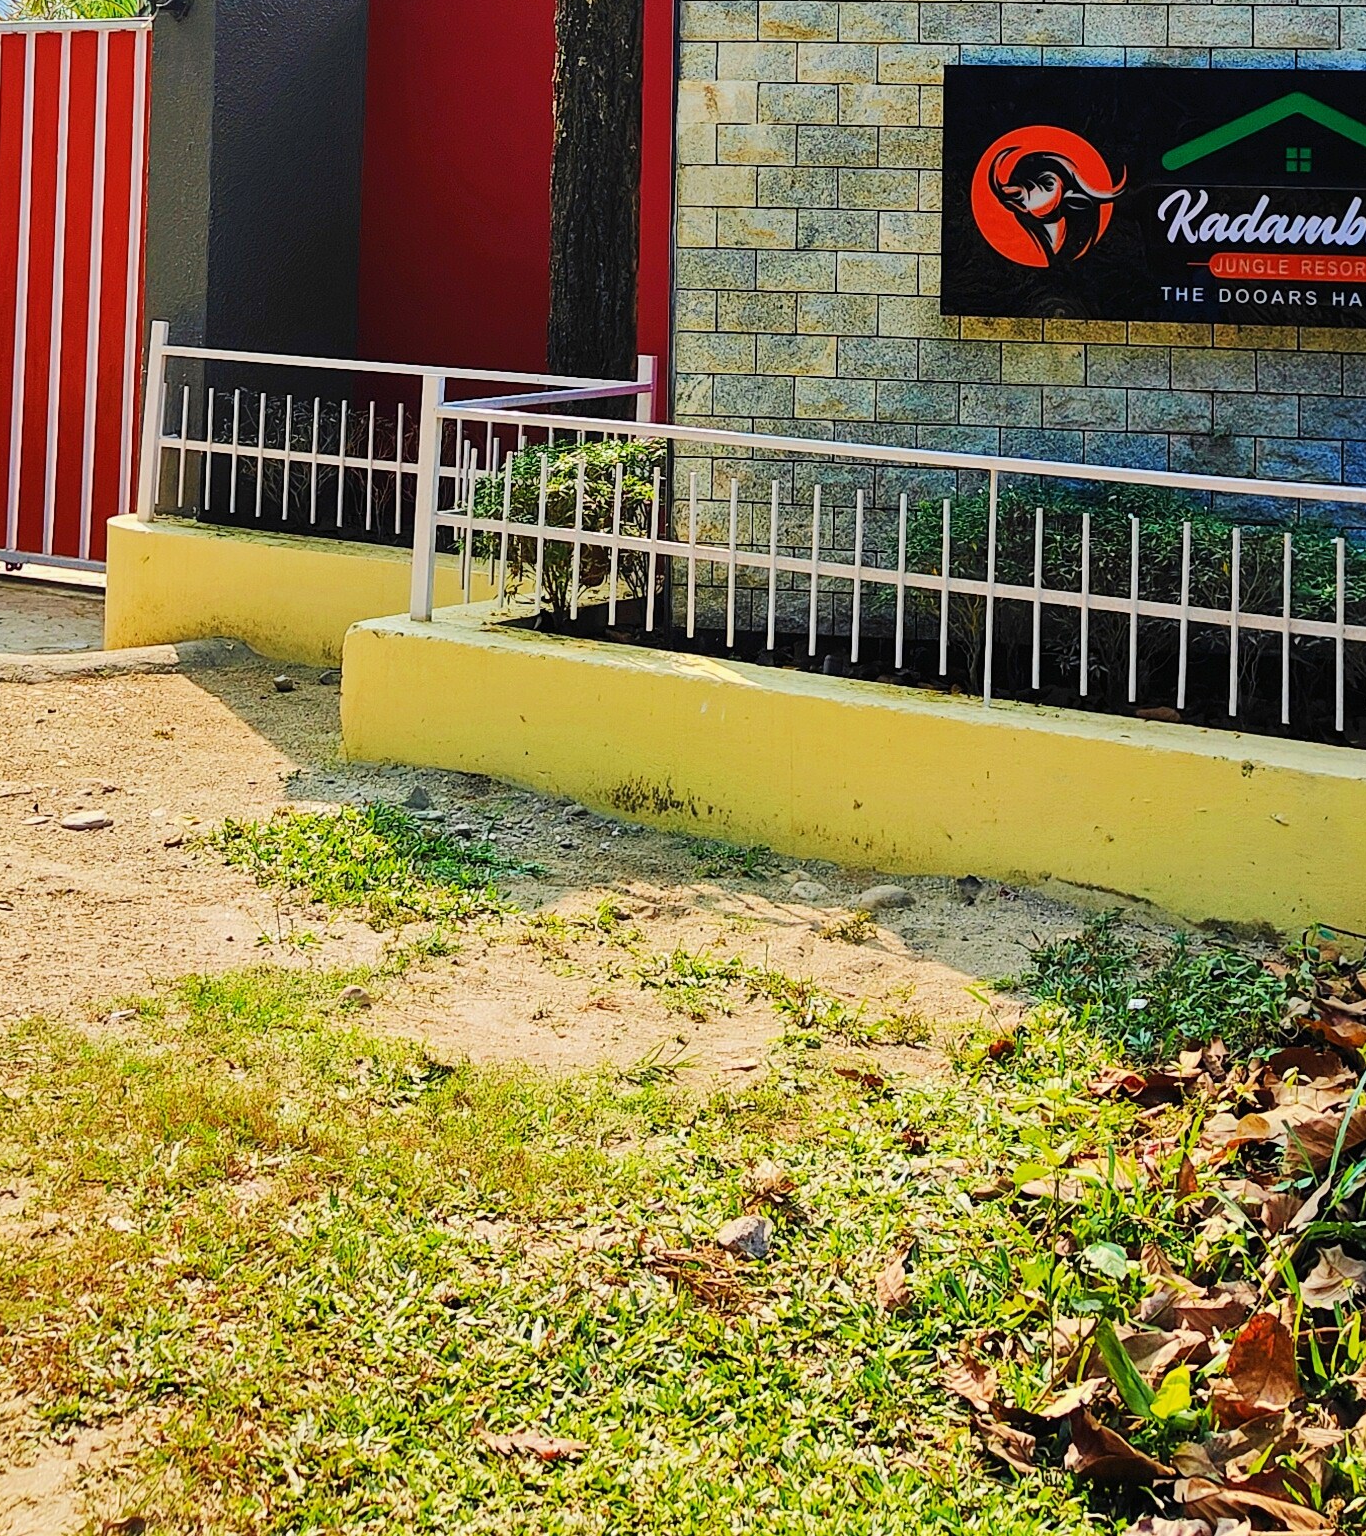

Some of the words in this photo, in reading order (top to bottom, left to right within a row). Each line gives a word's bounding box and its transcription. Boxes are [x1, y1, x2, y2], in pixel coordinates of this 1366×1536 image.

[1214, 259, 1289, 275] JUNGLE
[1161, 287, 1204, 302] THE
[1219, 289, 1317, 305] DOOARS
